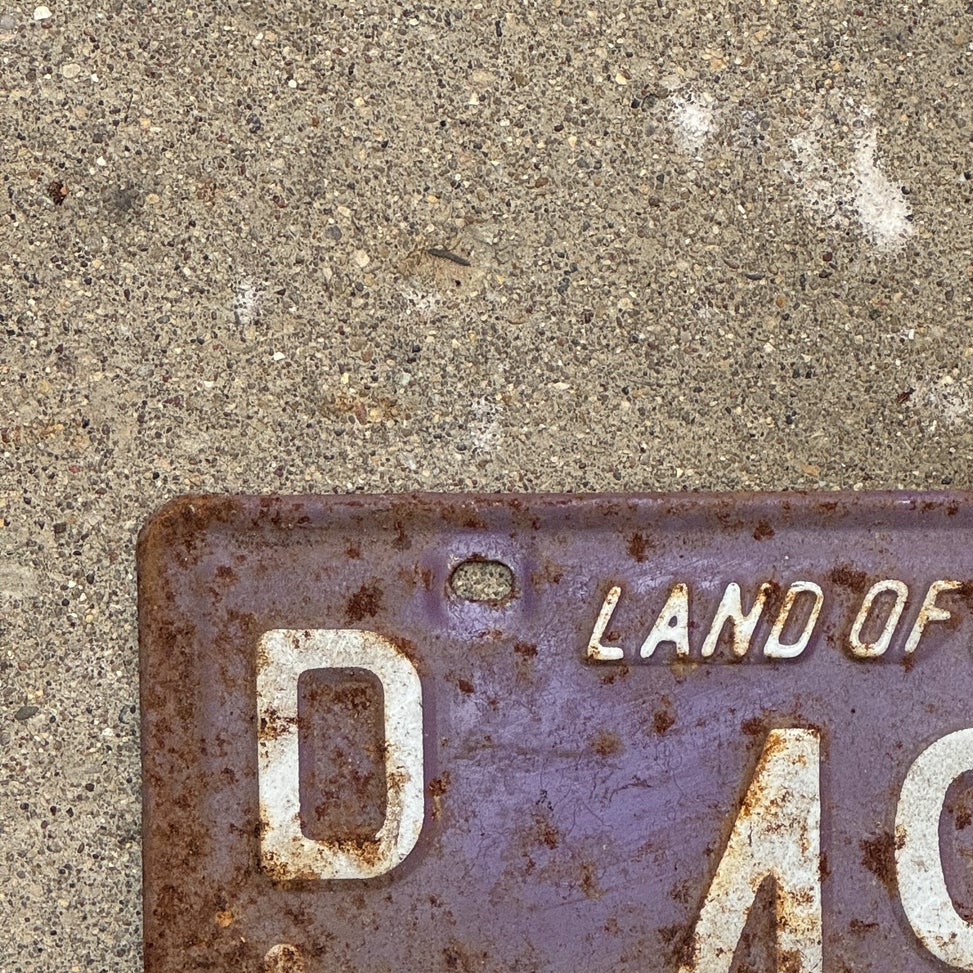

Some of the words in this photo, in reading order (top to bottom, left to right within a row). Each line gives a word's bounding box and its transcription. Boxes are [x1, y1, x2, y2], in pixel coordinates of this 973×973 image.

[586, 581, 824, 660] LAND
[849, 579, 962, 658] OF
[257, 629, 423, 879] D
